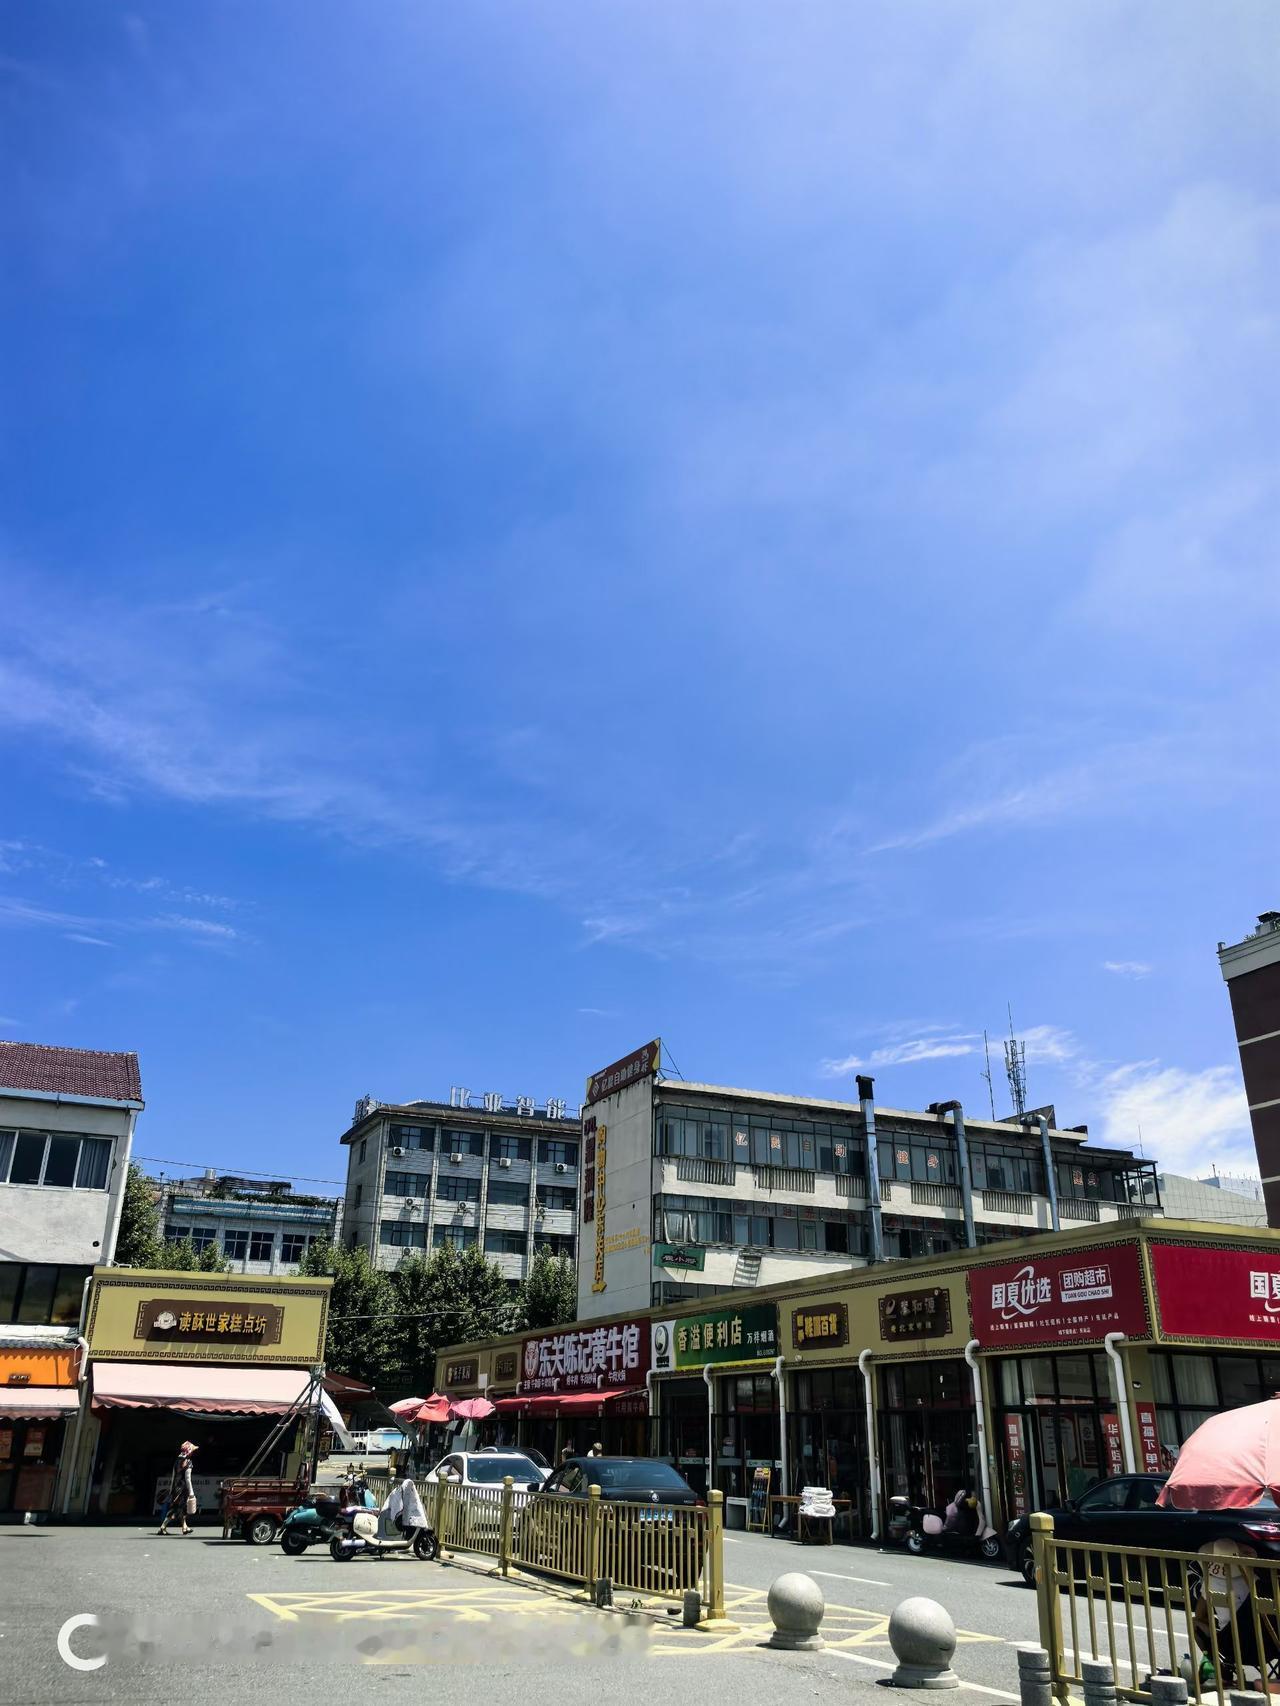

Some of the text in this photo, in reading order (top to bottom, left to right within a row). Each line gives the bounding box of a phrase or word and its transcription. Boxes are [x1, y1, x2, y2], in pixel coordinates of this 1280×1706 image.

[991, 1268, 1106, 1312] 国夏优选 团购超市
[1065, 1292, 1077, 1300] TUAN
[1077, 1291, 1087, 1299] GOU
[1101, 1288, 1110, 1296] SHI
[179, 1311, 267, 1334] 读酥世家糕点坊
[678, 1315, 742, 1352] 香溢便利店
[538, 1324, 640, 1377] 东关陈记黄牛馆
